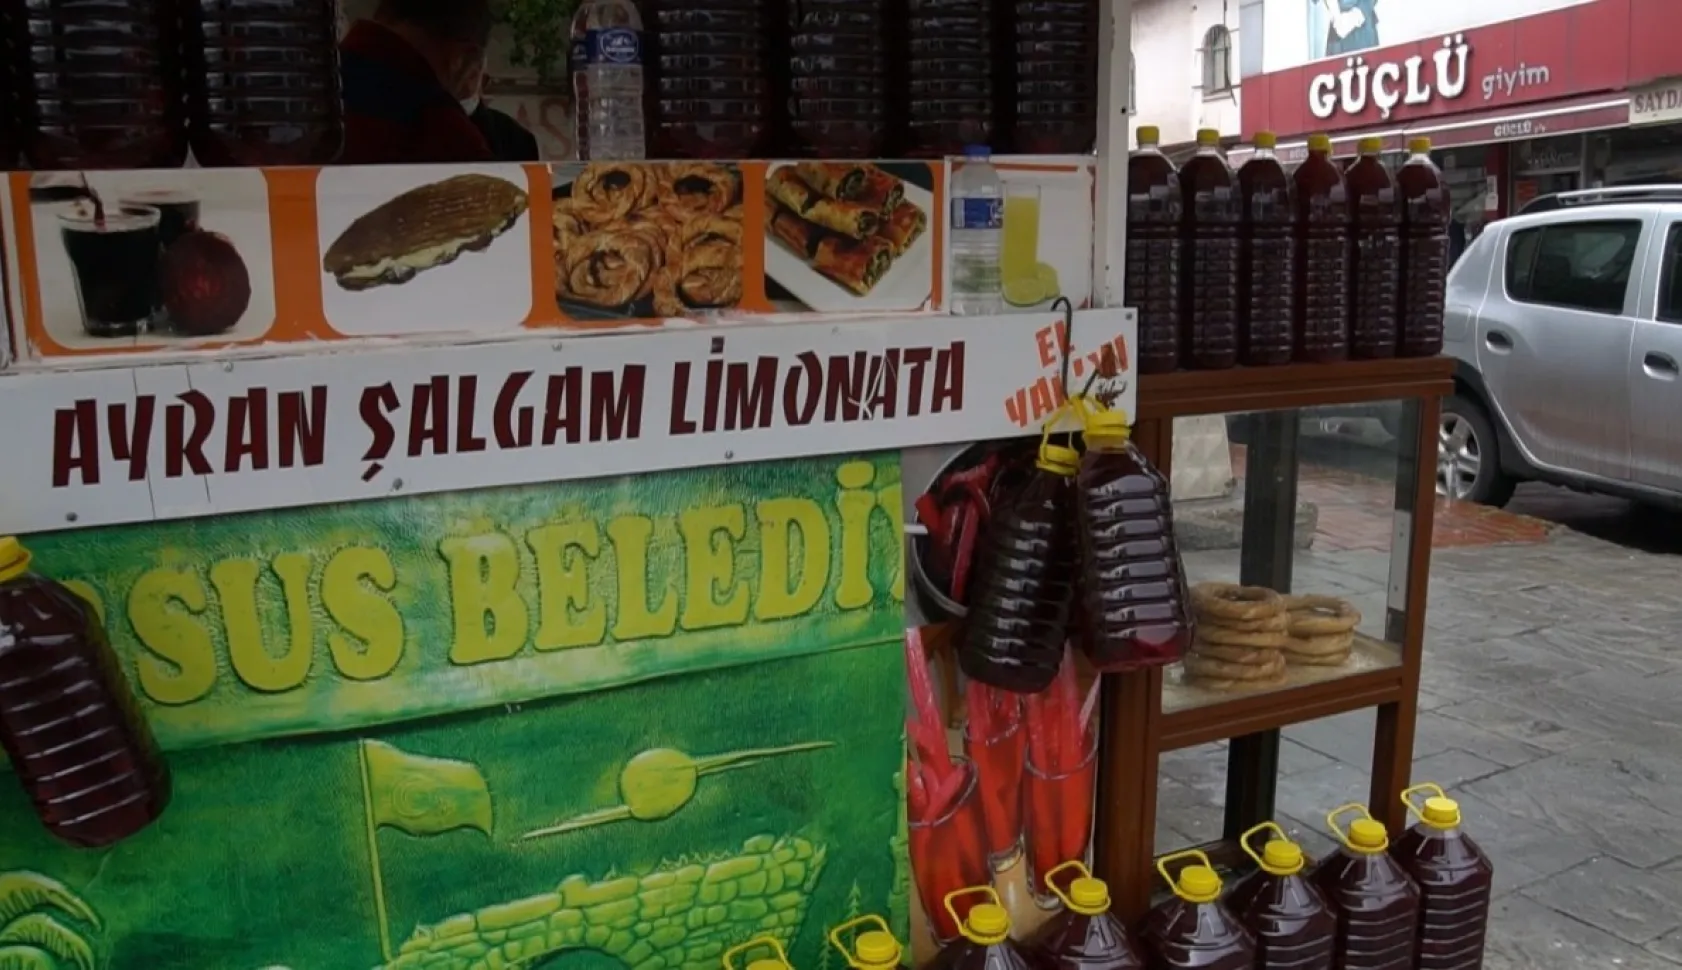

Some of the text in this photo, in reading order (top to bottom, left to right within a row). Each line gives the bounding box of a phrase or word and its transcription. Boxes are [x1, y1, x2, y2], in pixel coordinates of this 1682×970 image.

[1309, 33, 1550, 119] GÜÇLÜ giyim
[52, 336, 966, 488] AYRAN ŞALGAM LİMONATA
[60, 546, 406, 707] SUS
